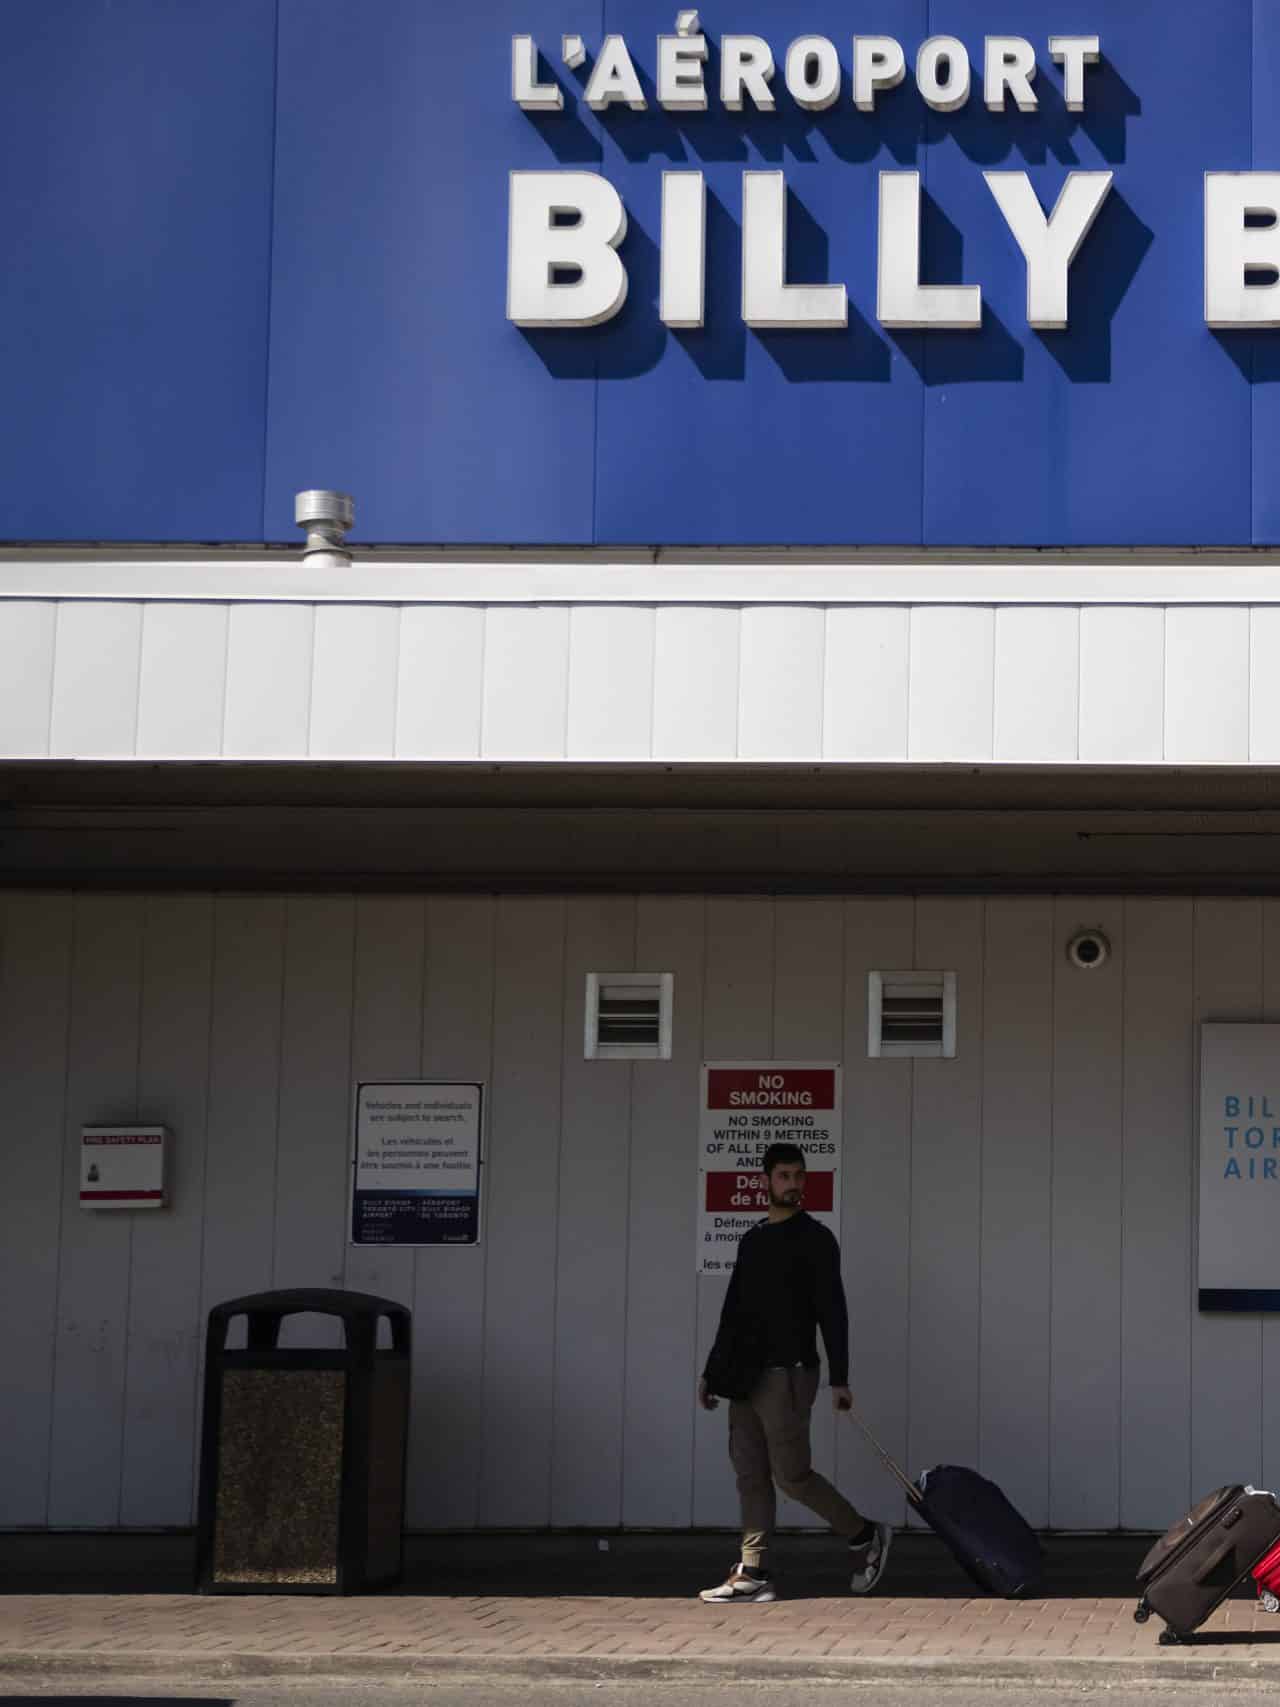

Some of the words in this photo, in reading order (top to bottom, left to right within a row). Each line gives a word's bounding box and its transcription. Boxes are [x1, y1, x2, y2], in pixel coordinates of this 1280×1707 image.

[511, 10, 1102, 111] L'AÉROPORT
[506, 170, 1114, 329] BILLY
[758, 1075, 785, 1089] NO
[729, 1091, 812, 1105] SMOKING
[728, 1116, 748, 1127] NO
[752, 1116, 814, 1127] SMOKING
[713, 1130, 760, 1140] WITHIN
[764, 1130, 771, 1140] 9
[775, 1130, 829, 1140] METRES
[706, 1143, 725, 1154] OF
[728, 1143, 752, 1154] ALL
[730, 1193, 752, 1206] de
[704, 1231, 712, 1242] à
[704, 1259, 721, 1270] les
